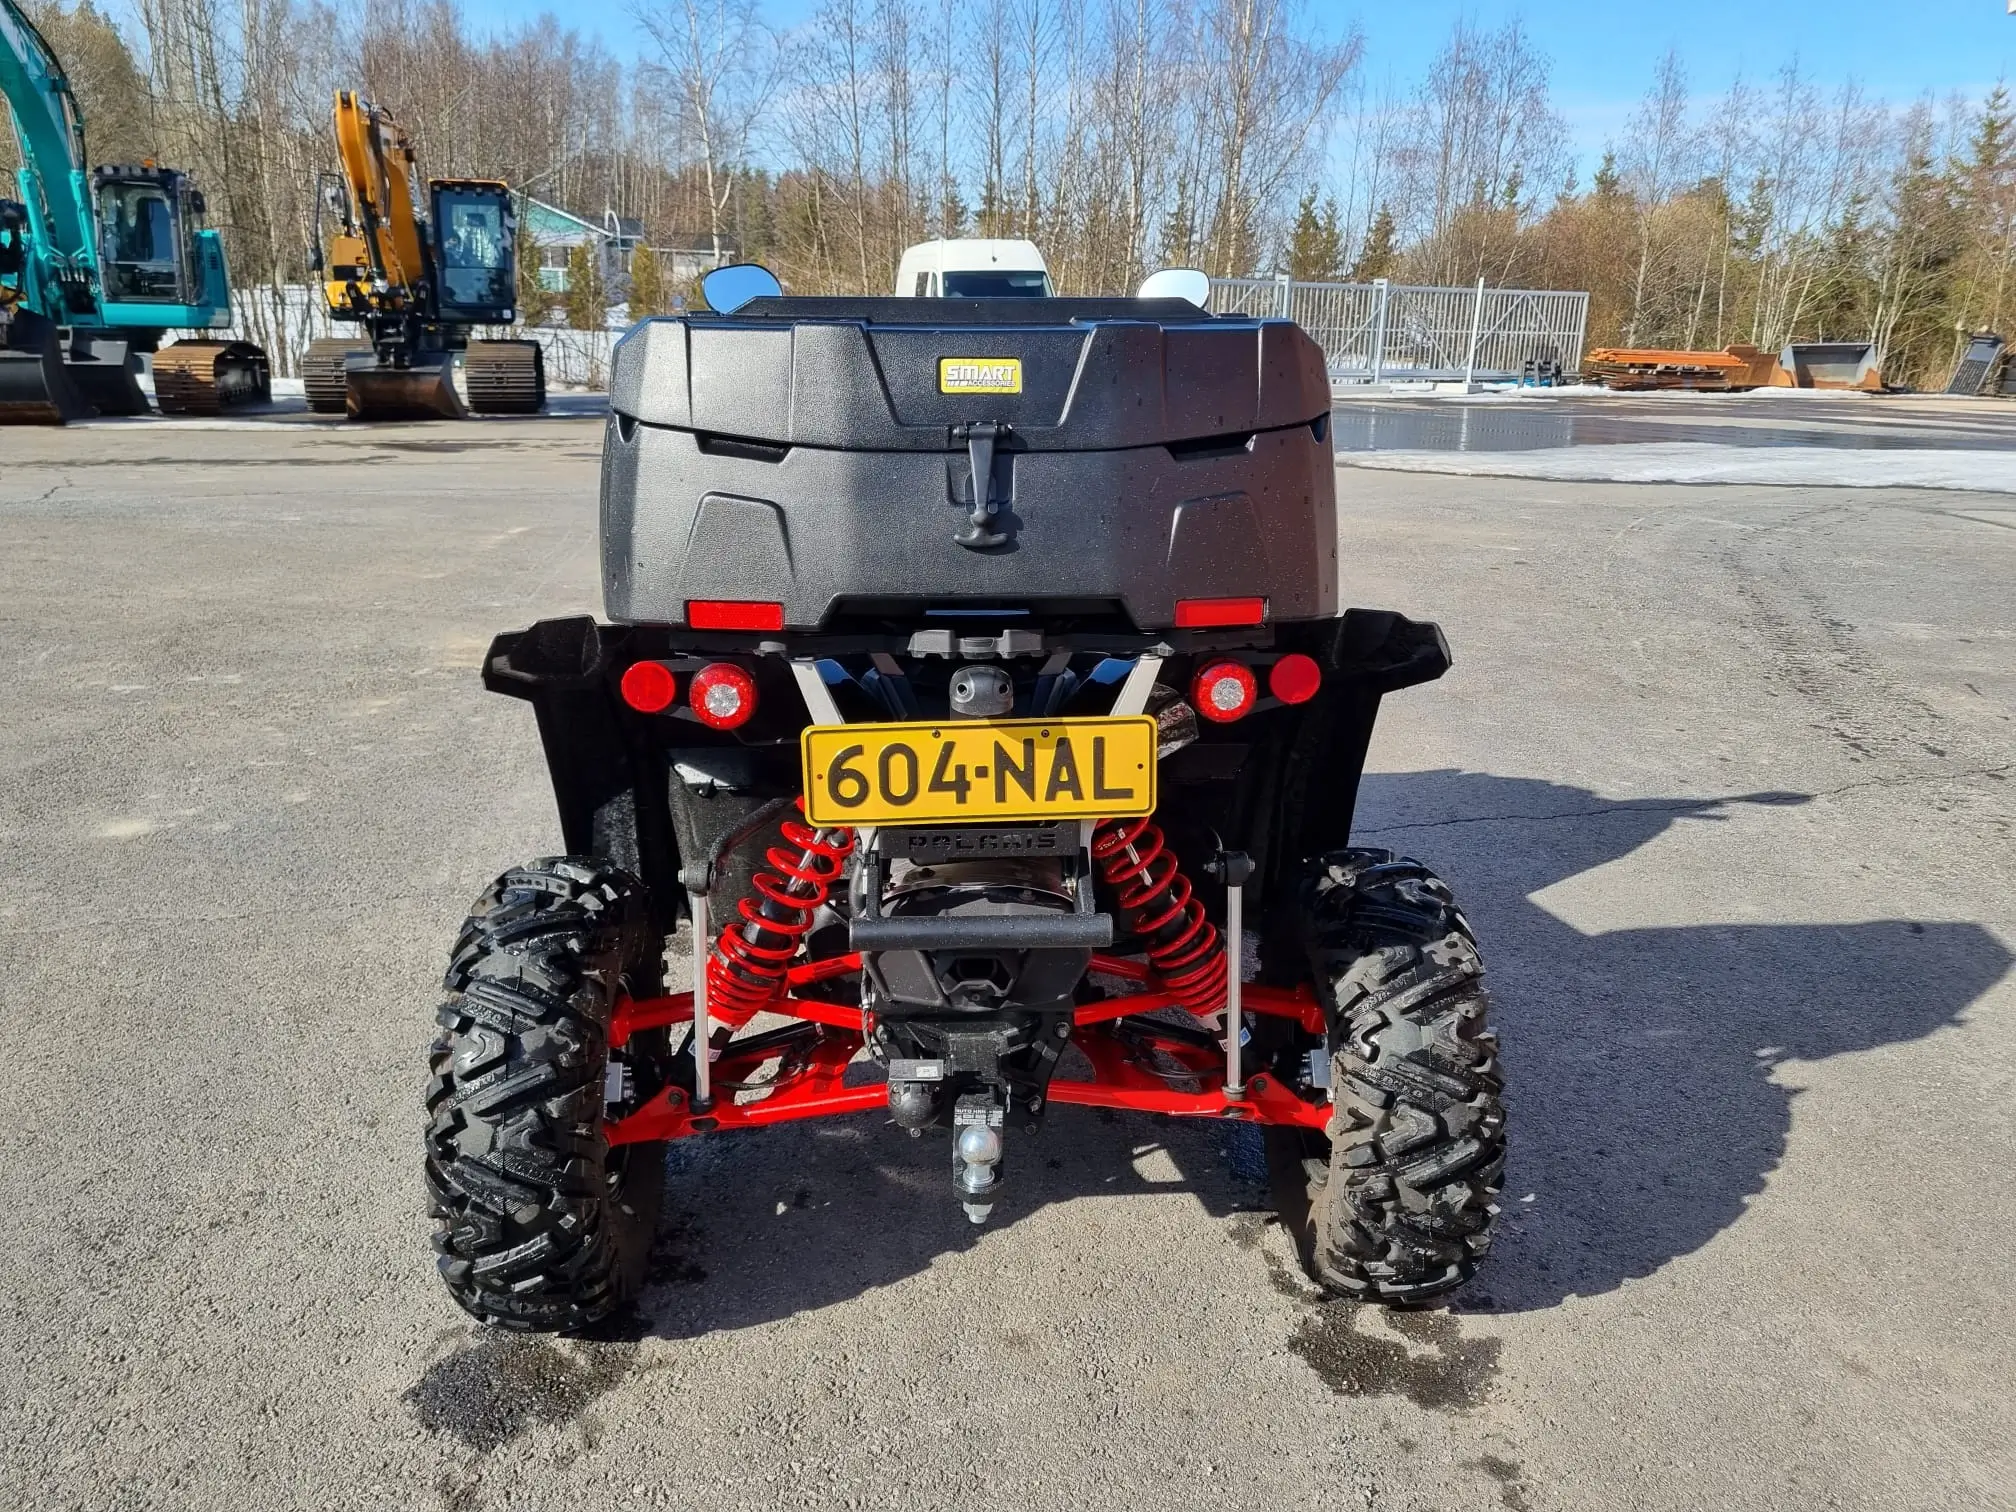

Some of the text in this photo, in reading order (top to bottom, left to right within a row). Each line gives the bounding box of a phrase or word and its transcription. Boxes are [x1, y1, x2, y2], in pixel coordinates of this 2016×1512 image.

[946, 365, 1016, 380] SMART
[827, 736, 1134, 808] 604-NAL
[908, 833, 1056, 850] POLARIS
